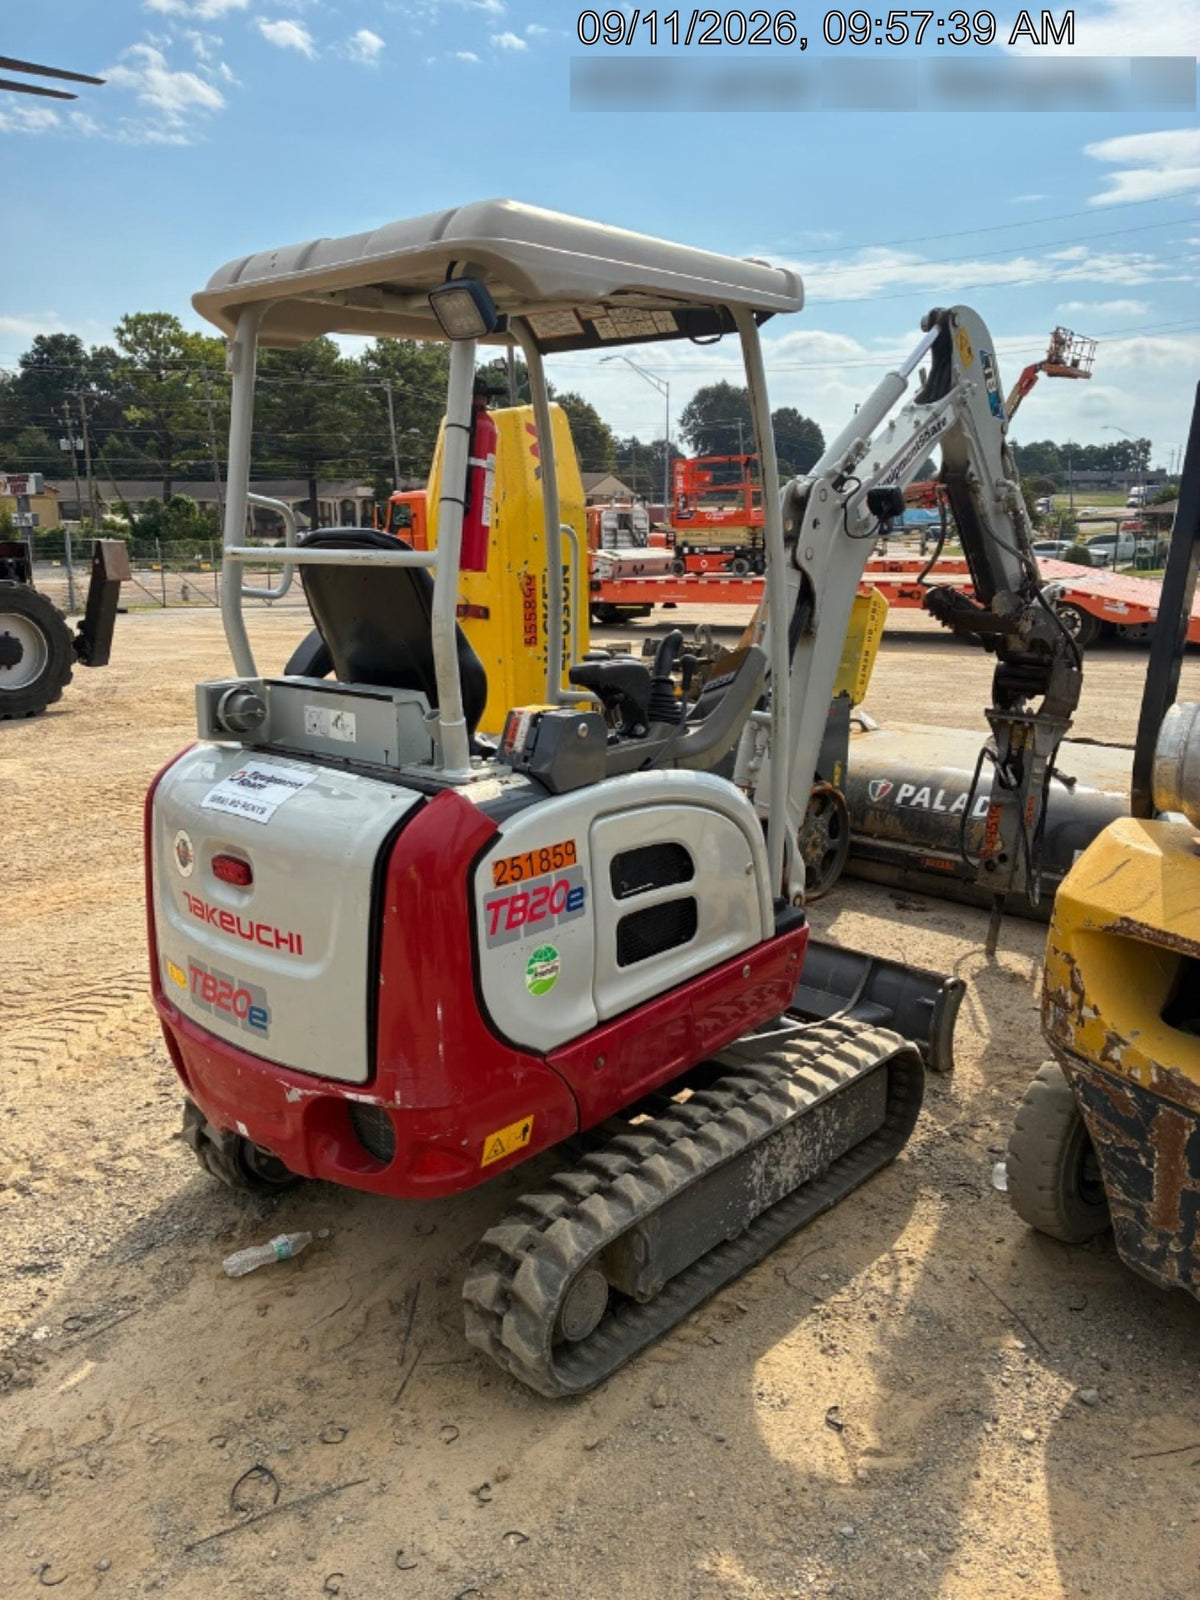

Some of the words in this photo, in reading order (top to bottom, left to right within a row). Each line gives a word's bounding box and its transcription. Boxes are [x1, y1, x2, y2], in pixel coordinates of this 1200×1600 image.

[494, 840, 577, 887] 251859
[486, 878, 584, 936] TB20e
[189, 964, 268, 1032] TB20e
